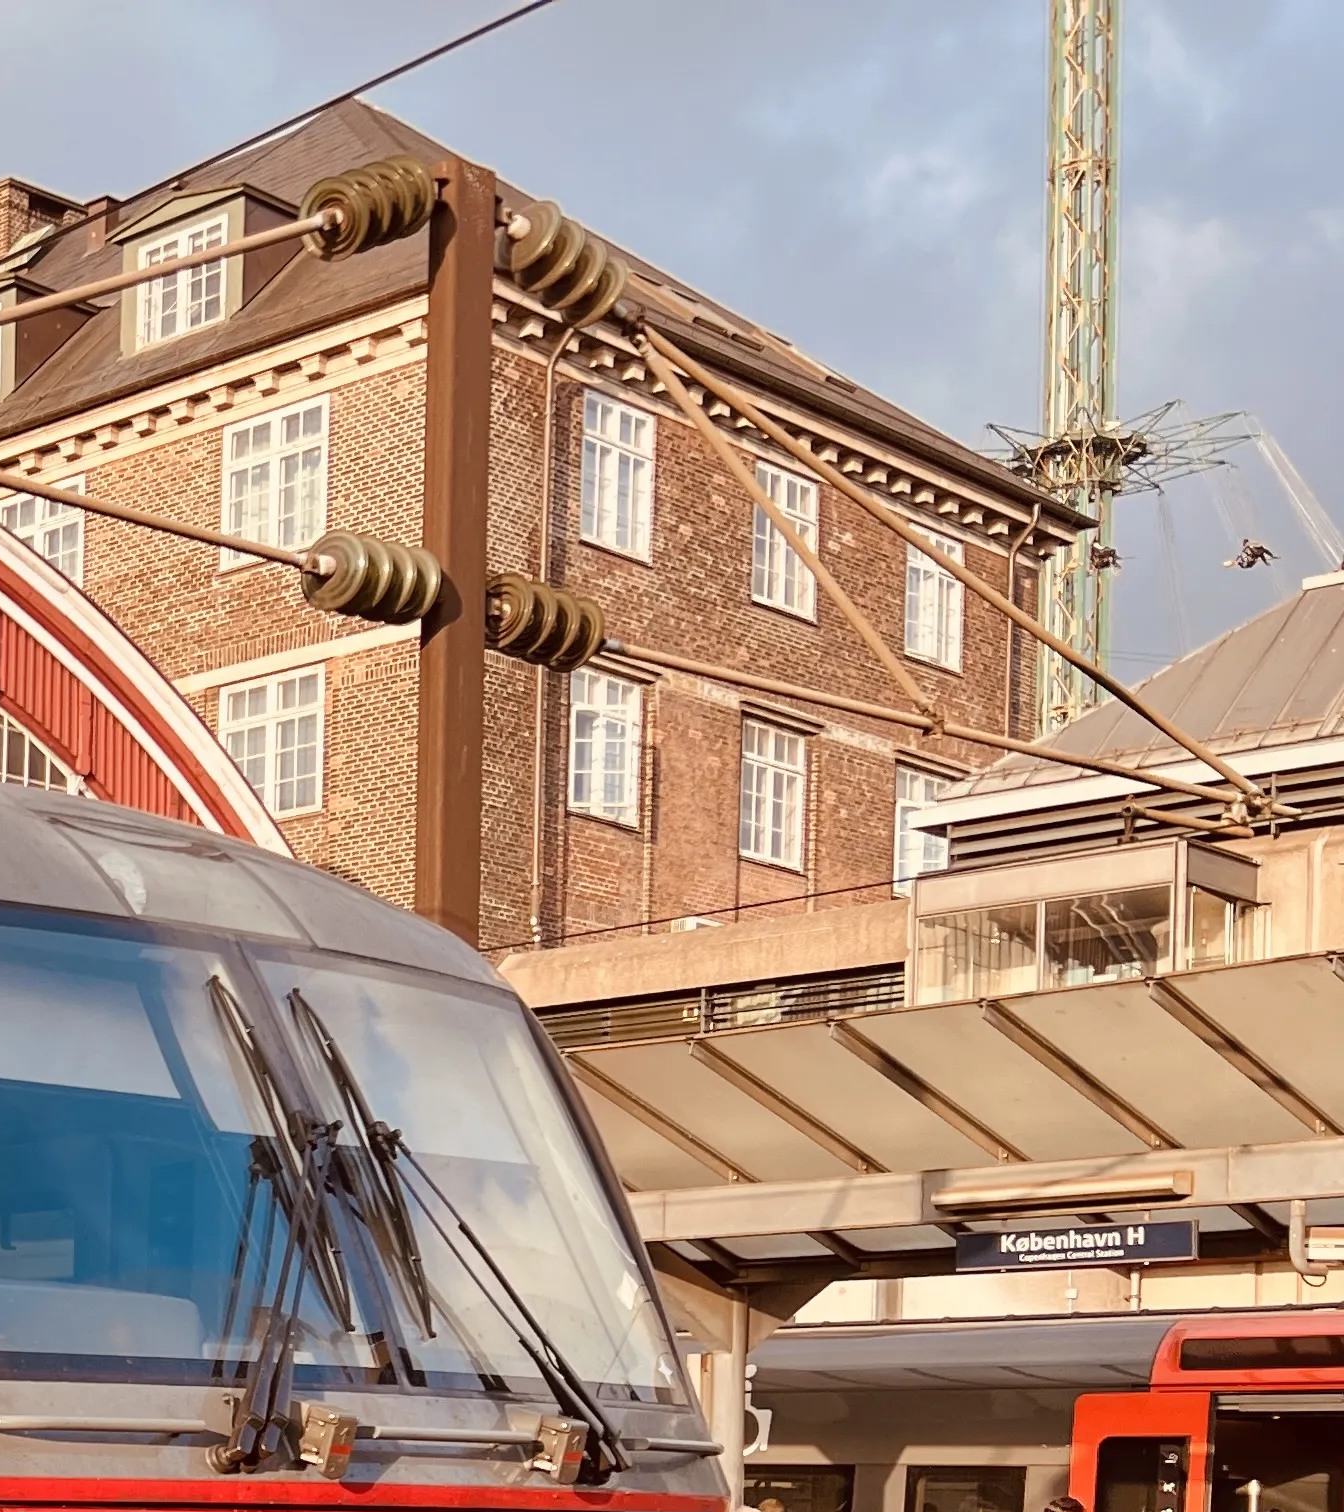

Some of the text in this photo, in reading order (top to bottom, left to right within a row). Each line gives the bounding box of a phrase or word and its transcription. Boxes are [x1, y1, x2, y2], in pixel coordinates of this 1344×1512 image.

[1000, 1226, 1145, 1253] København H
[1067, 1250, 1094, 1260] Central
[1096, 1249, 1124, 1258] Station
